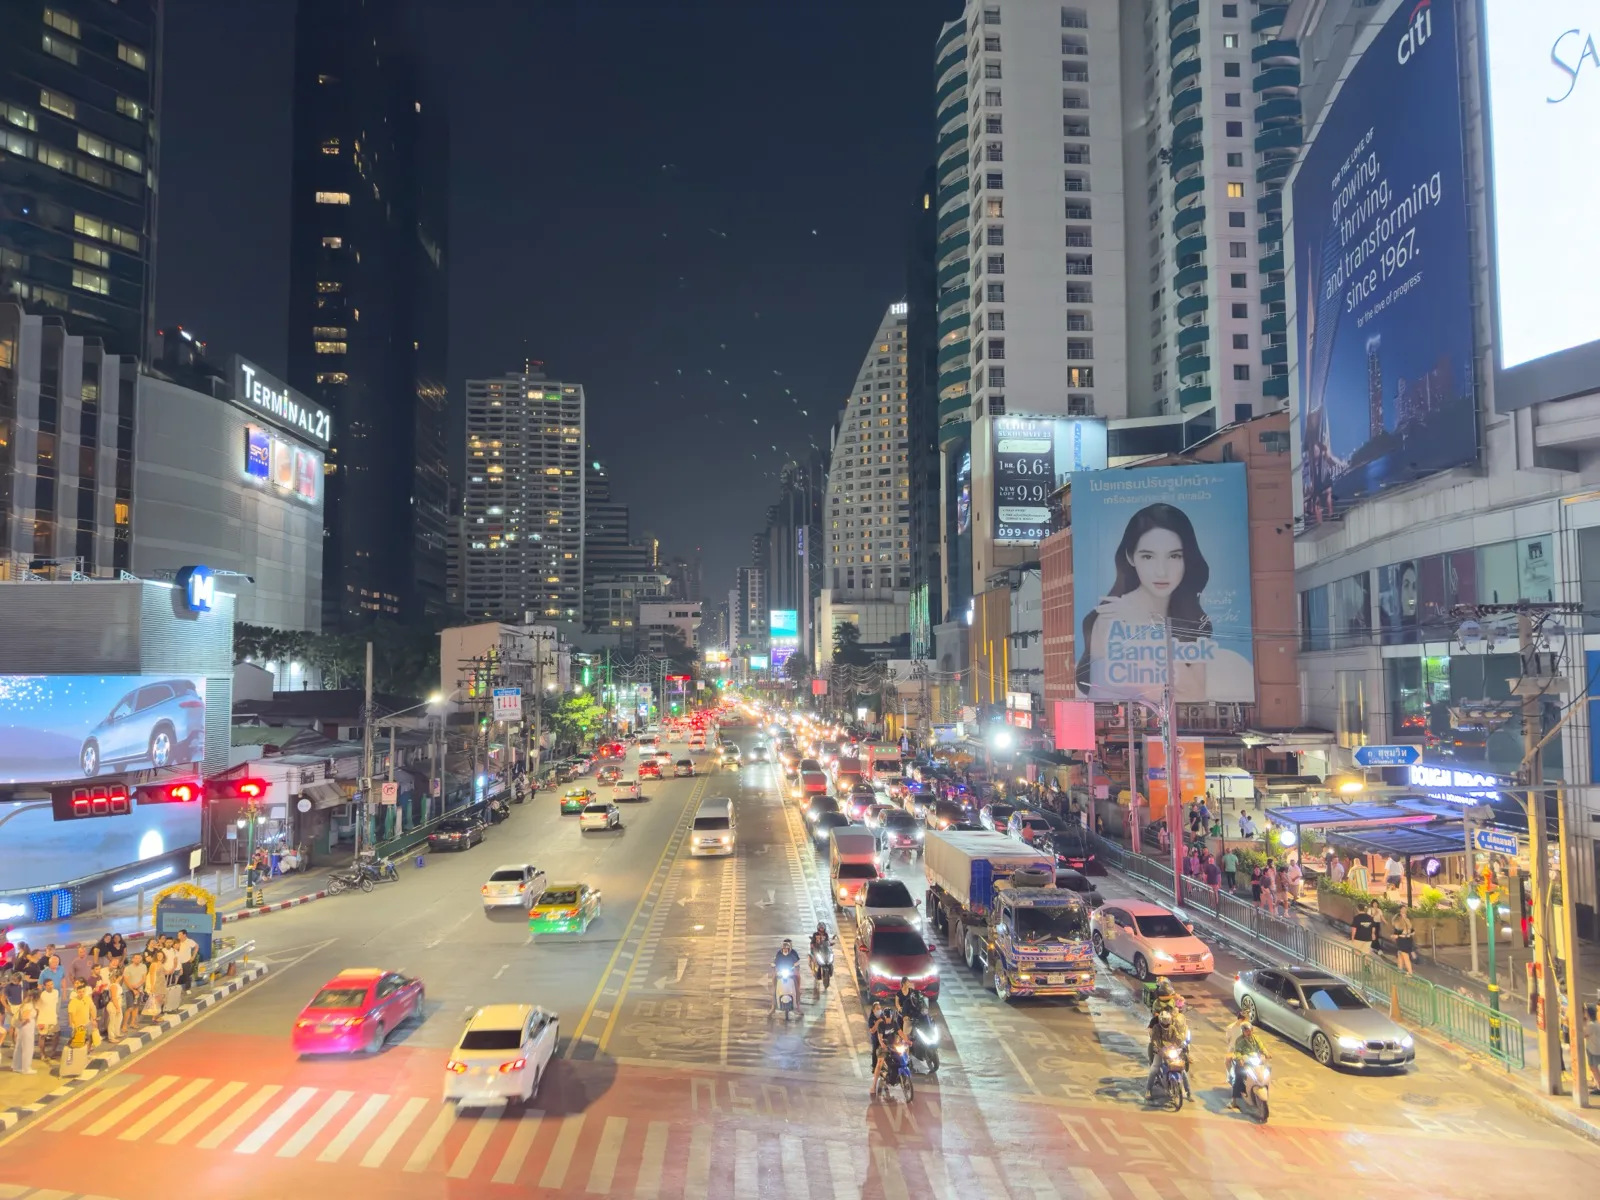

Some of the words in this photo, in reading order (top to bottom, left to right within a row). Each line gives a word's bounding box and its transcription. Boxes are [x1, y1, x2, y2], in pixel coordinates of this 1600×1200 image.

[1398, 9, 1431, 65] citi
[1332, 173, 1341, 191] FOR
[1341, 160, 1350, 175] THE
[1351, 141, 1365, 163] LOVE
[1366, 127, 1374, 143] OF
[1332, 151, 1380, 226] growing,
[1341, 179, 1392, 246] thriving,
[1326, 259, 1343, 300] and
[1345, 171, 1441, 278] transforming
[1347, 269, 1376, 312] since
[1380, 227, 1420, 281] 1967.
[1357, 317, 1365, 328] for
[1365, 309, 1373, 322] the
[1374, 300, 1385, 315] love
[1016, 458, 1043, 475] 6.6
[1016, 485, 1043, 501] 9.9
[1108, 640, 1215, 666] Bangkok
[1109, 620, 1165, 640] Aura
